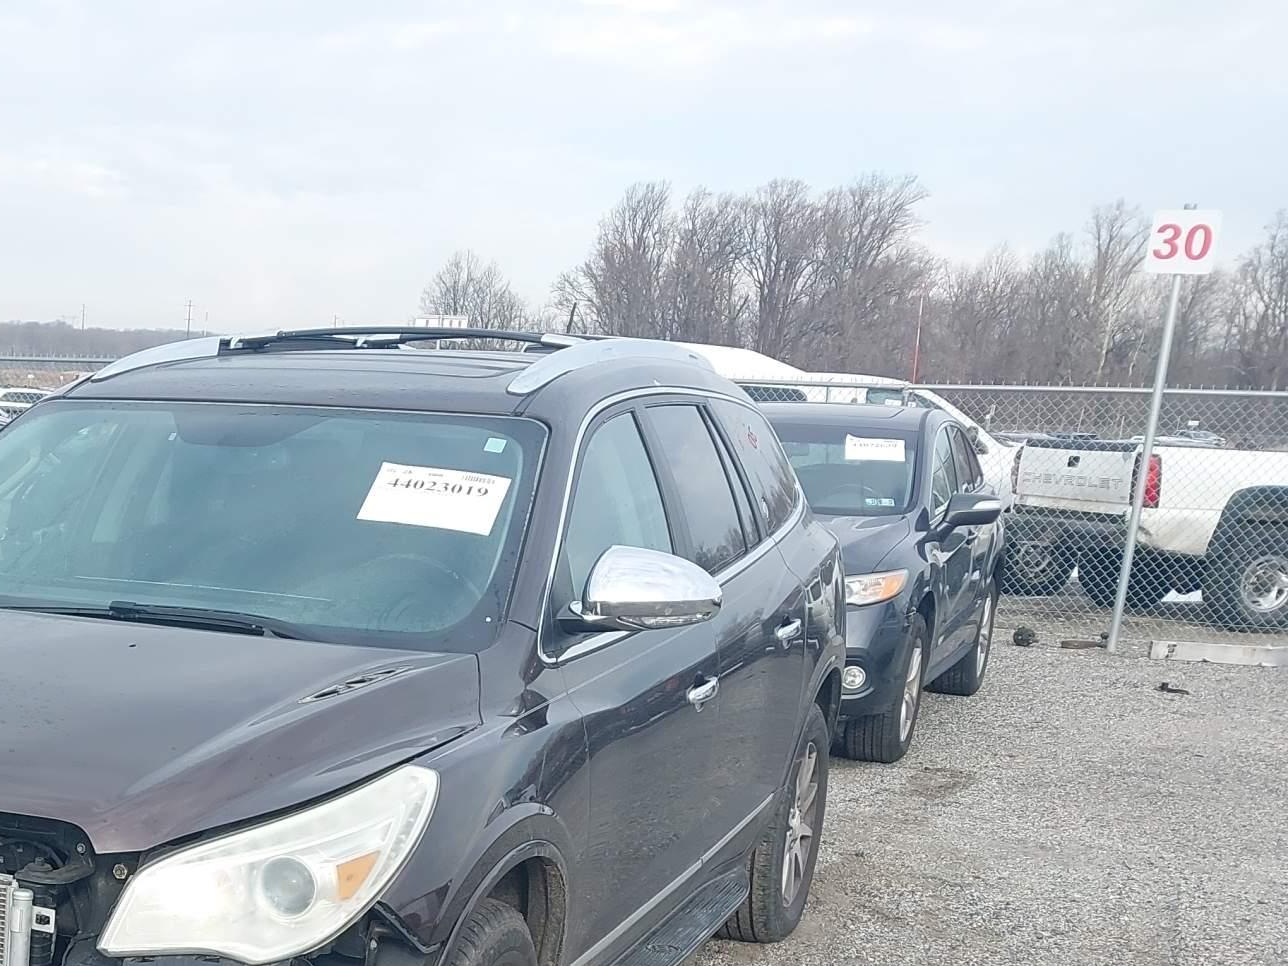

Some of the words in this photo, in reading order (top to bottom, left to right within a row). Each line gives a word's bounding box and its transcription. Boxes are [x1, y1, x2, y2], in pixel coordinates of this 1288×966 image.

[1153, 223, 1213, 261] 30
[386, 477, 489, 497] 44023019
[1022, 471, 1123, 490] CHEVROLET
